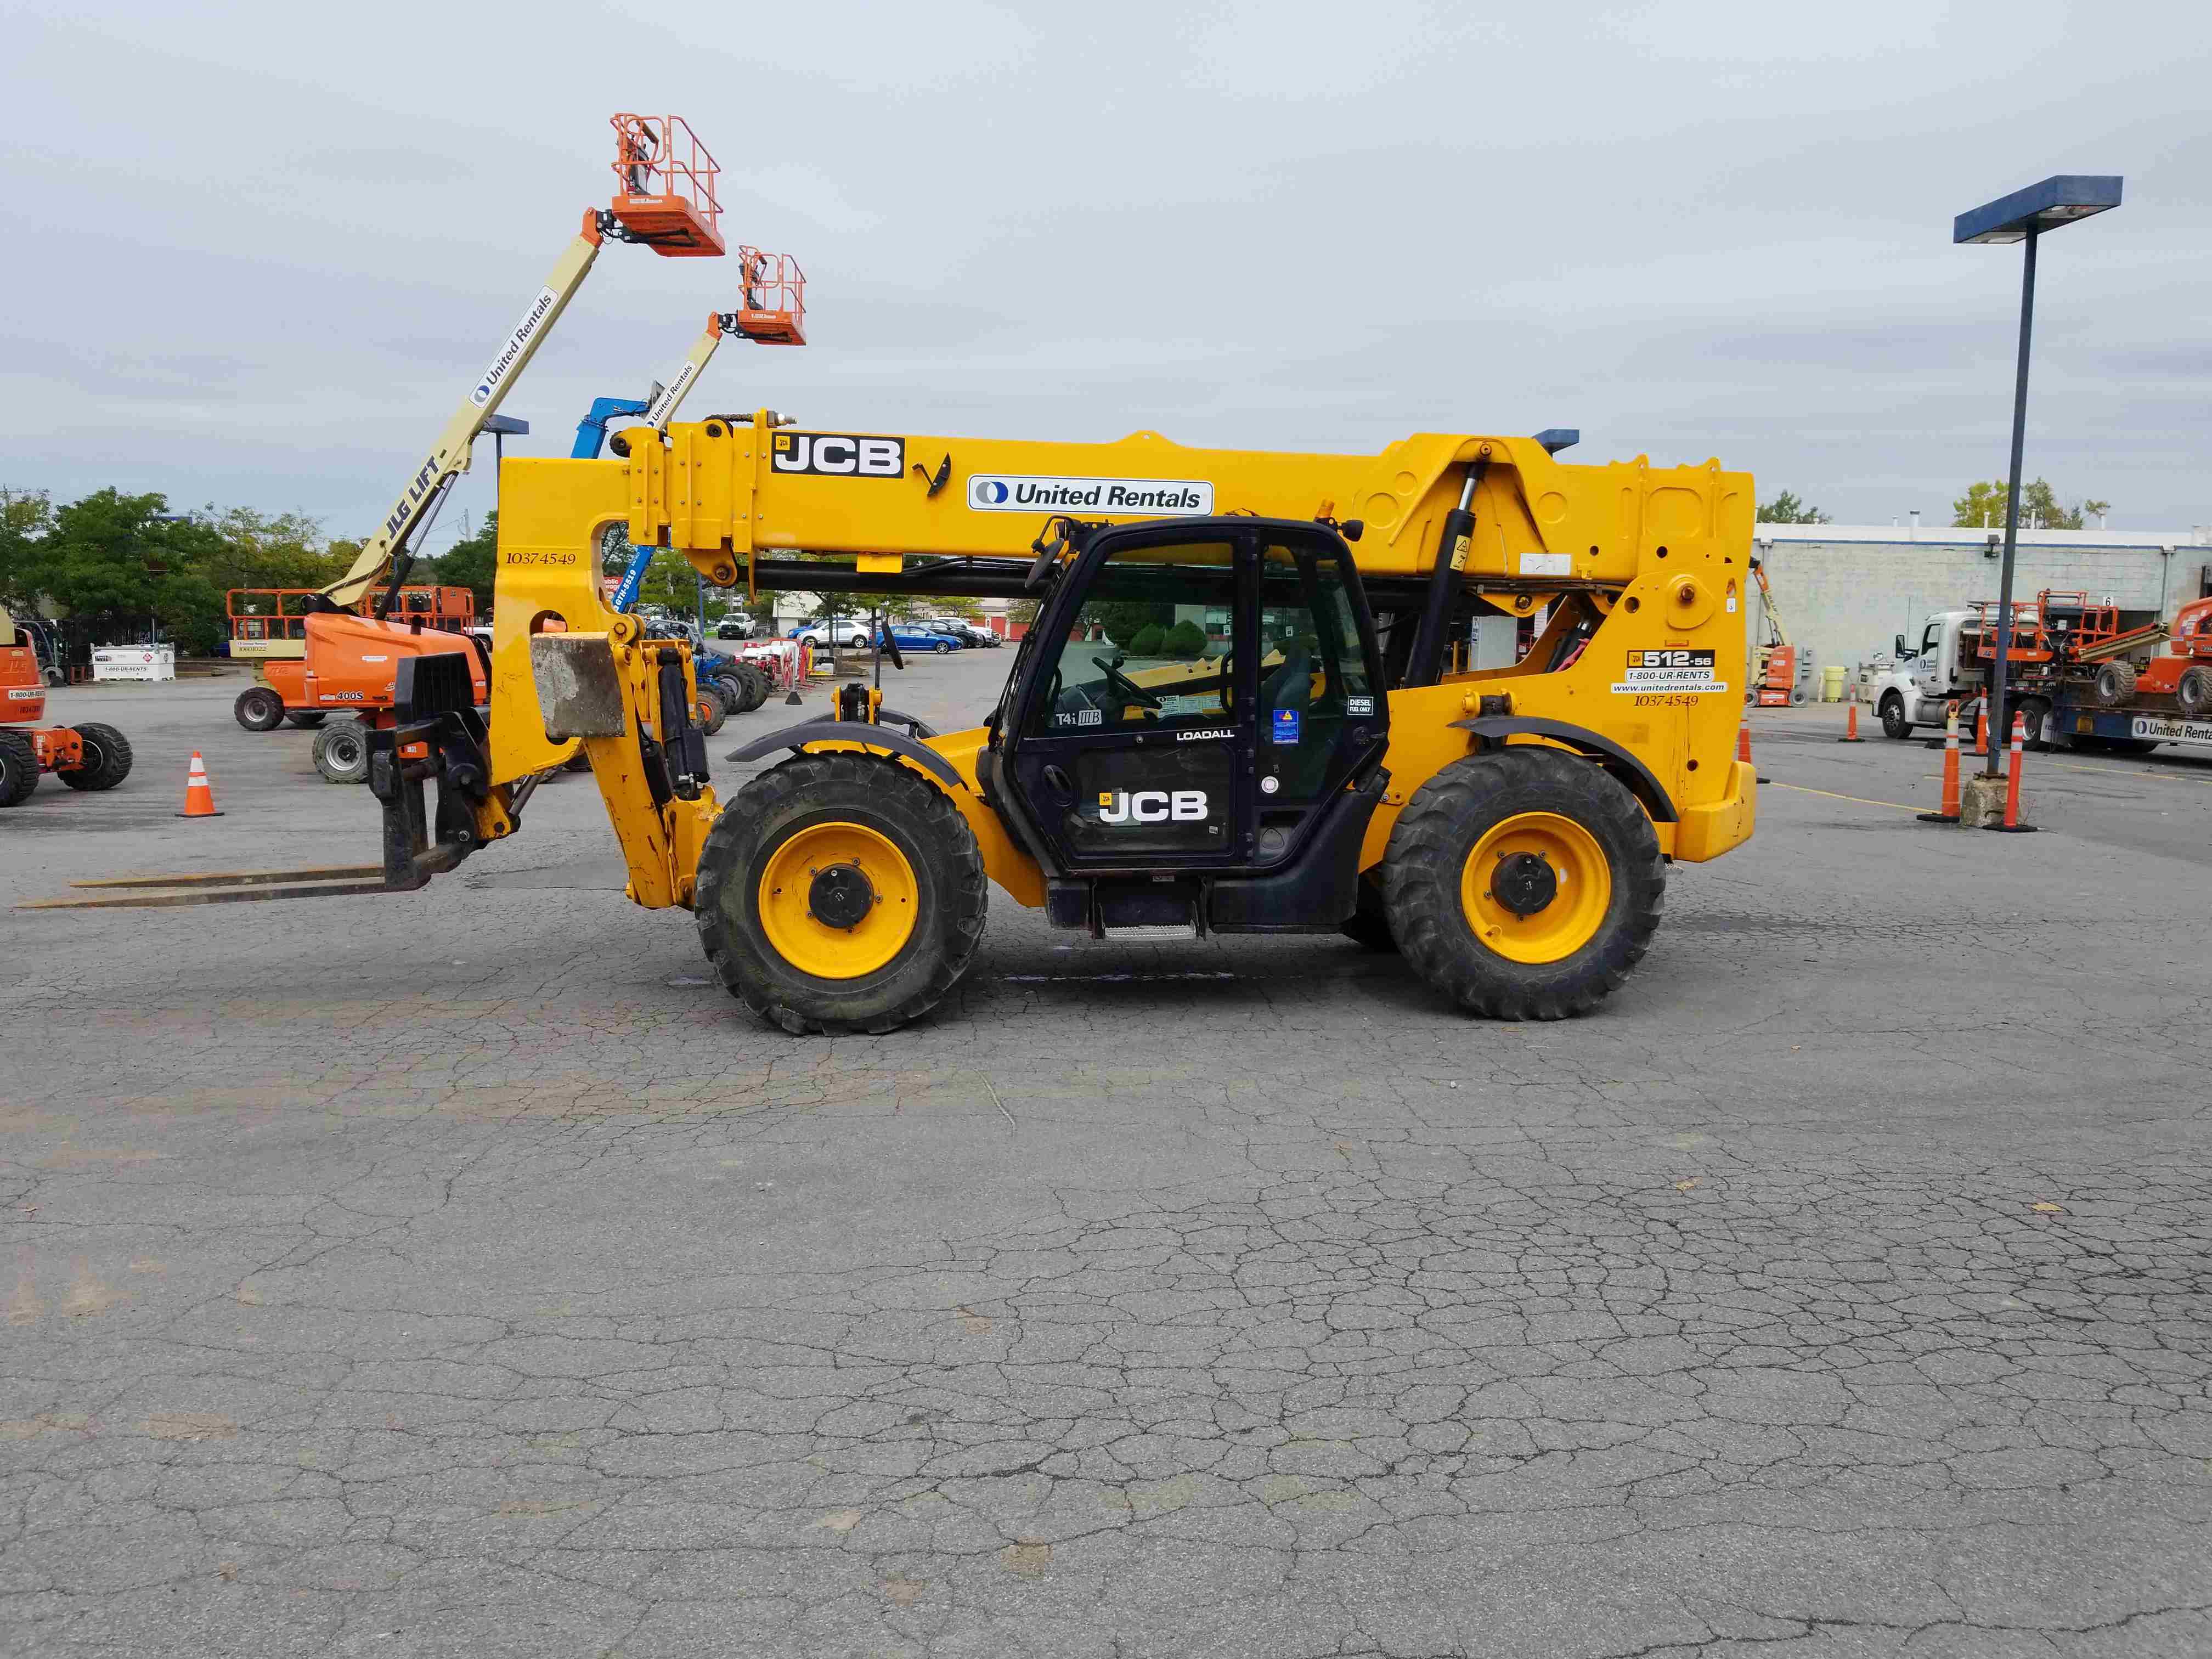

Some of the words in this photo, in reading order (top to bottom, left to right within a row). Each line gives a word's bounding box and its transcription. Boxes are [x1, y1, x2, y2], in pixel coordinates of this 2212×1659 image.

[486, 340, 519, 385] United
[516, 295, 551, 342] Rentals
[652, 393, 673, 421] United
[670, 365, 692, 394] Rentals
[775, 436, 901, 474] JCB
[386, 498, 411, 540] JLG
[408, 455, 439, 504] LIFT
[1015, 483, 1102, 505] United
[1107, 486, 1200, 509] Rentals
[506, 552, 575, 565] 10374549
[616, 569, 636, 606] GTH-5519
[2106, 597, 2111, 606] 6
[1644, 651, 1712, 667] 512-56
[1629, 671, 1709, 680] 1-800-UR-RENTS
[337, 692, 364, 700] 400S
[1634, 695, 1699, 707] 10374549
[1176, 730, 1235, 741] LOADALL
[2149, 722, 2183, 737] United
[2185, 725, 2212, 740] Renta
[1099, 791, 1207, 822] JCB
